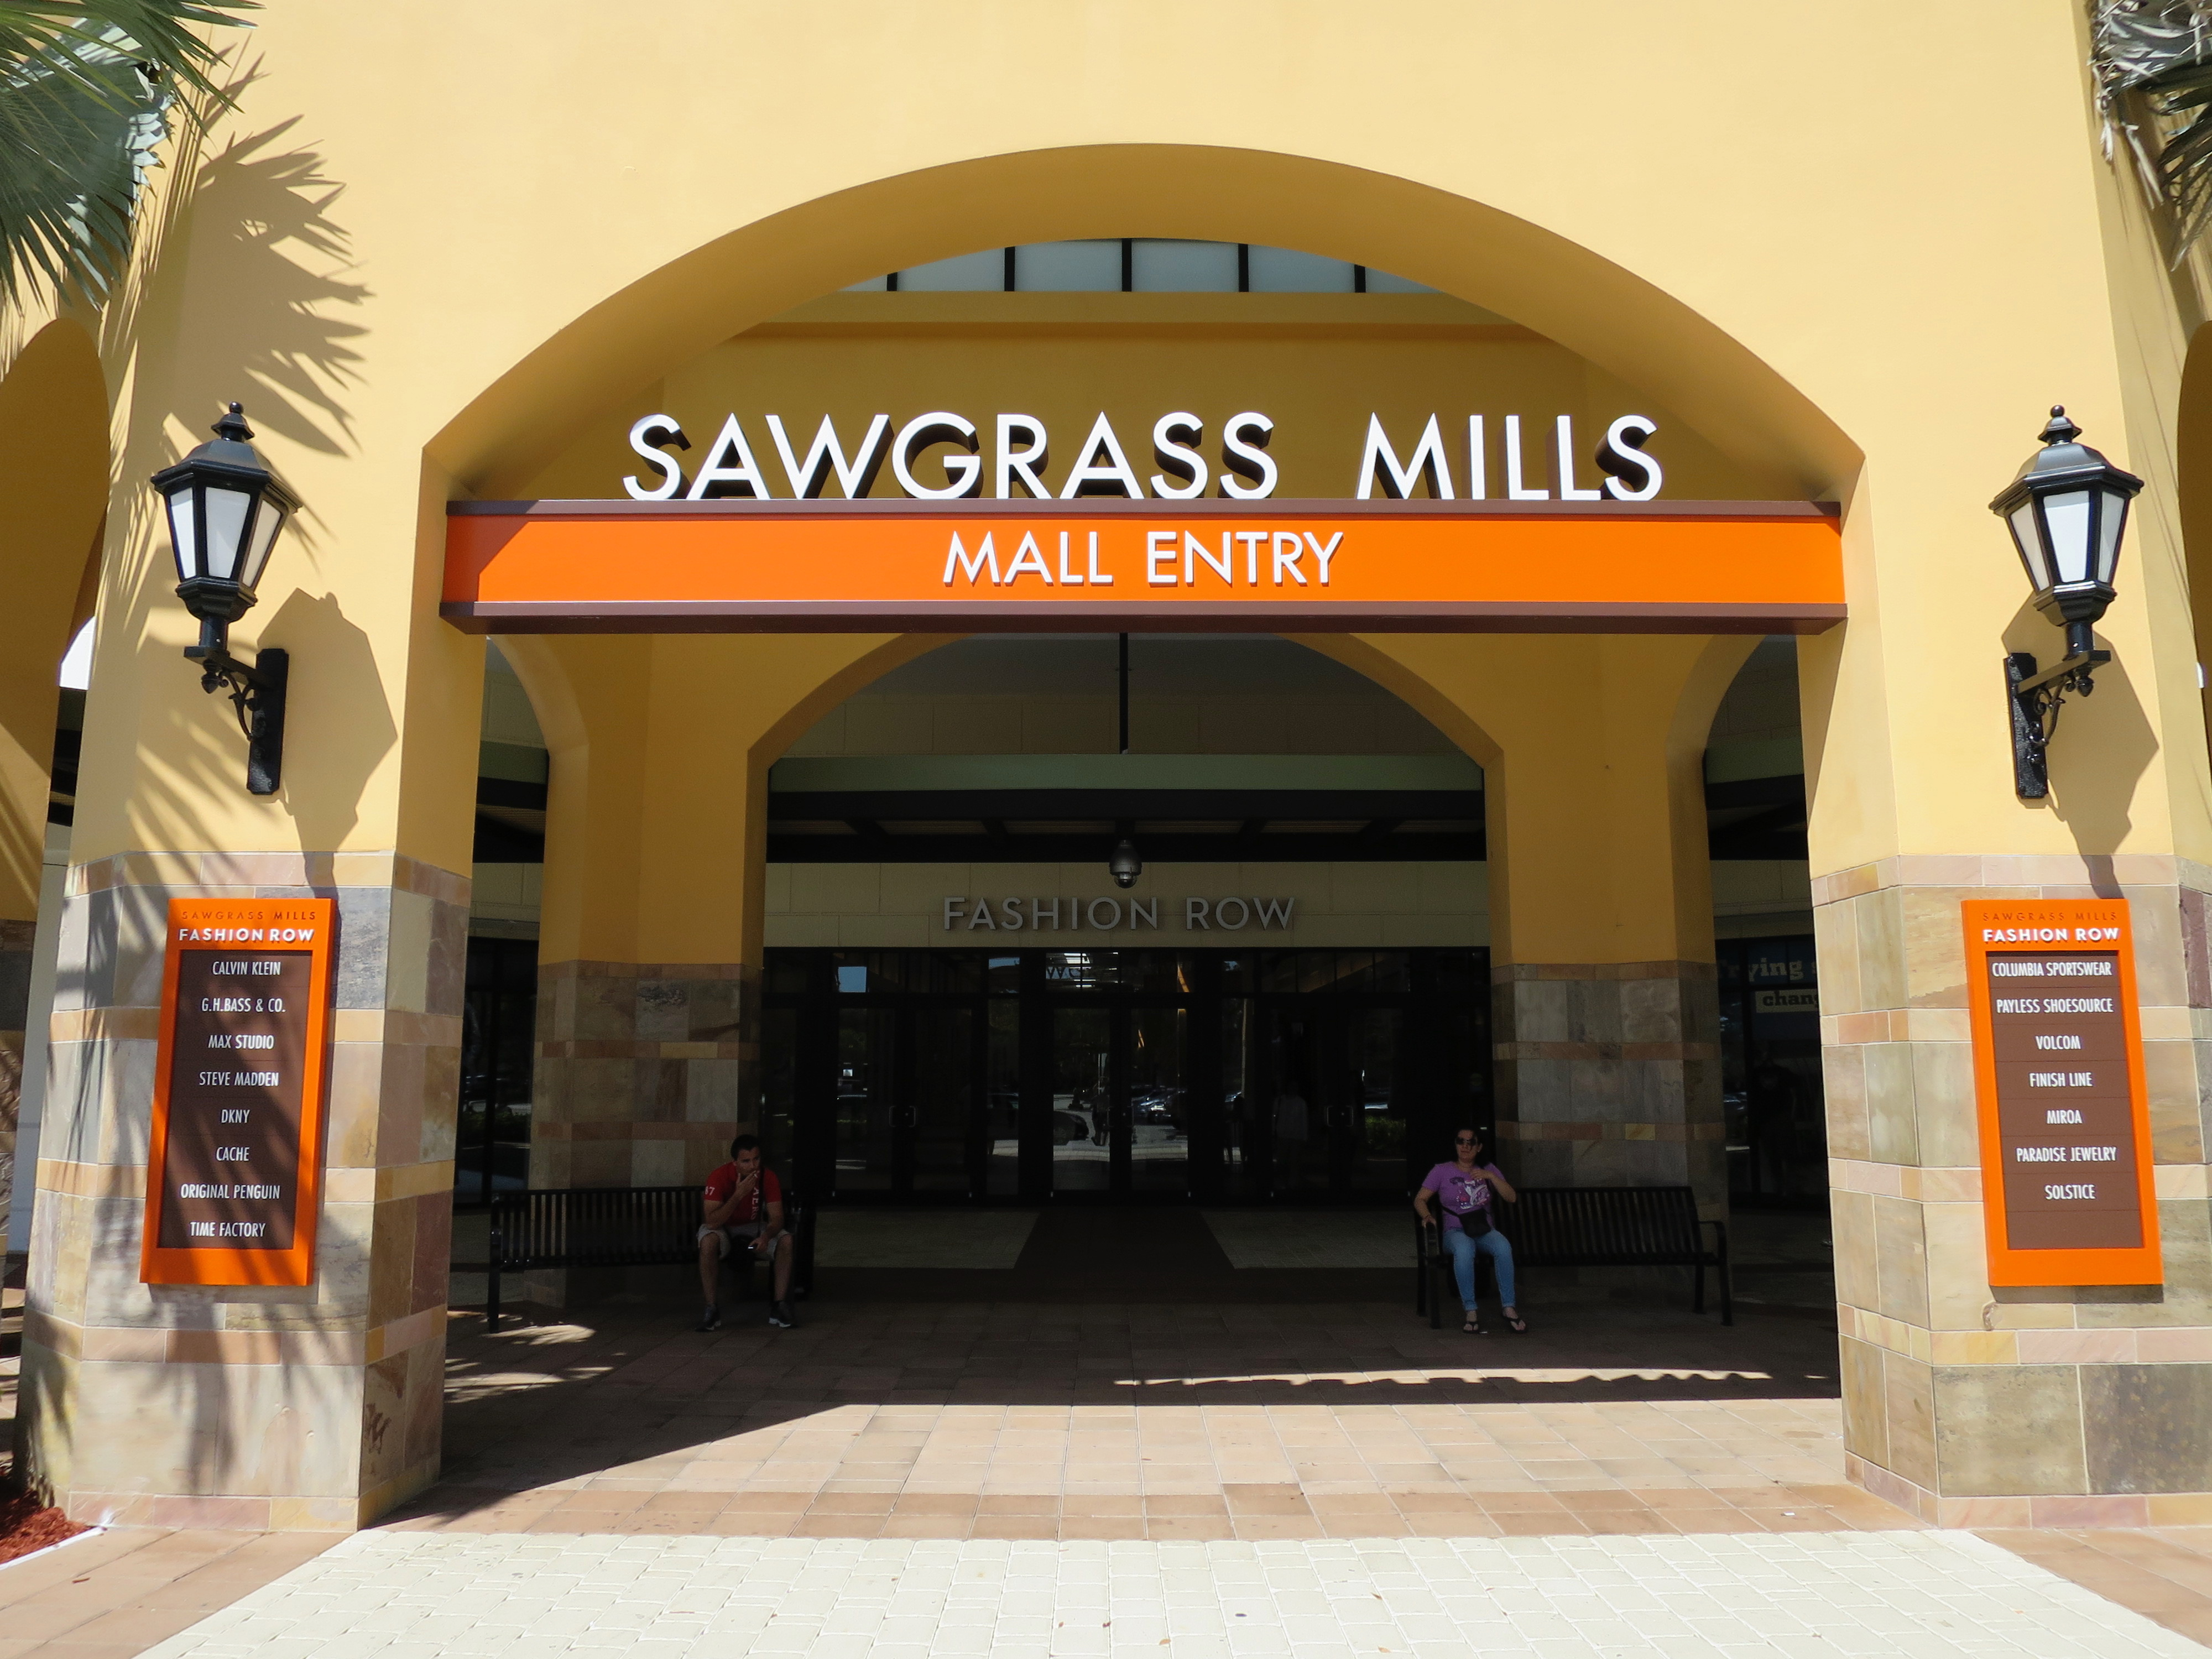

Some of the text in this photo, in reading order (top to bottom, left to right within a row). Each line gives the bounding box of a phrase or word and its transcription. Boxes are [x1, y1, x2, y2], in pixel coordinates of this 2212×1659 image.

[622, 411, 1663, 501] SAWGRASS MILLS
[943, 530, 1344, 587] MALL ENTRY
[943, 896, 1296, 931] FASHION ROW
[1983, 912, 2065, 921] SAWGRASS
[179, 928, 314, 941] FASHION ROW
[1983, 928, 2118, 942] FASHION ROW
[212, 962, 281, 975] CALVIN KLEIN
[1992, 962, 2112, 977] COLUMBIA SPORTSWEAR
[201, 998, 286, 1012] G.H.BASS & CO.
[1762, 990, 1818, 1007] chan
[1996, 999, 2114, 1013] PAYLESS SHOESOURCE
[208, 1035, 274, 1049] MAX STUDIO
[2036, 1036, 2081, 1050] VOLCOM
[199, 1072, 279, 1086] STEVE MADDEN
[2030, 1072, 2093, 1087] FINISH LINE
[221, 1109, 250, 1123] DKNY
[2047, 1110, 2083, 1124] MIROA
[216, 1147, 249, 1161] CACHE
[2016, 1147, 2117, 1162] PARADISE JEWELRY
[180, 1184, 280, 1199] ORIGINAL PENGUIN
[2044, 1185, 2096, 1199] SOLSTICE
[190, 1222, 266, 1237] TIME FACTORY
